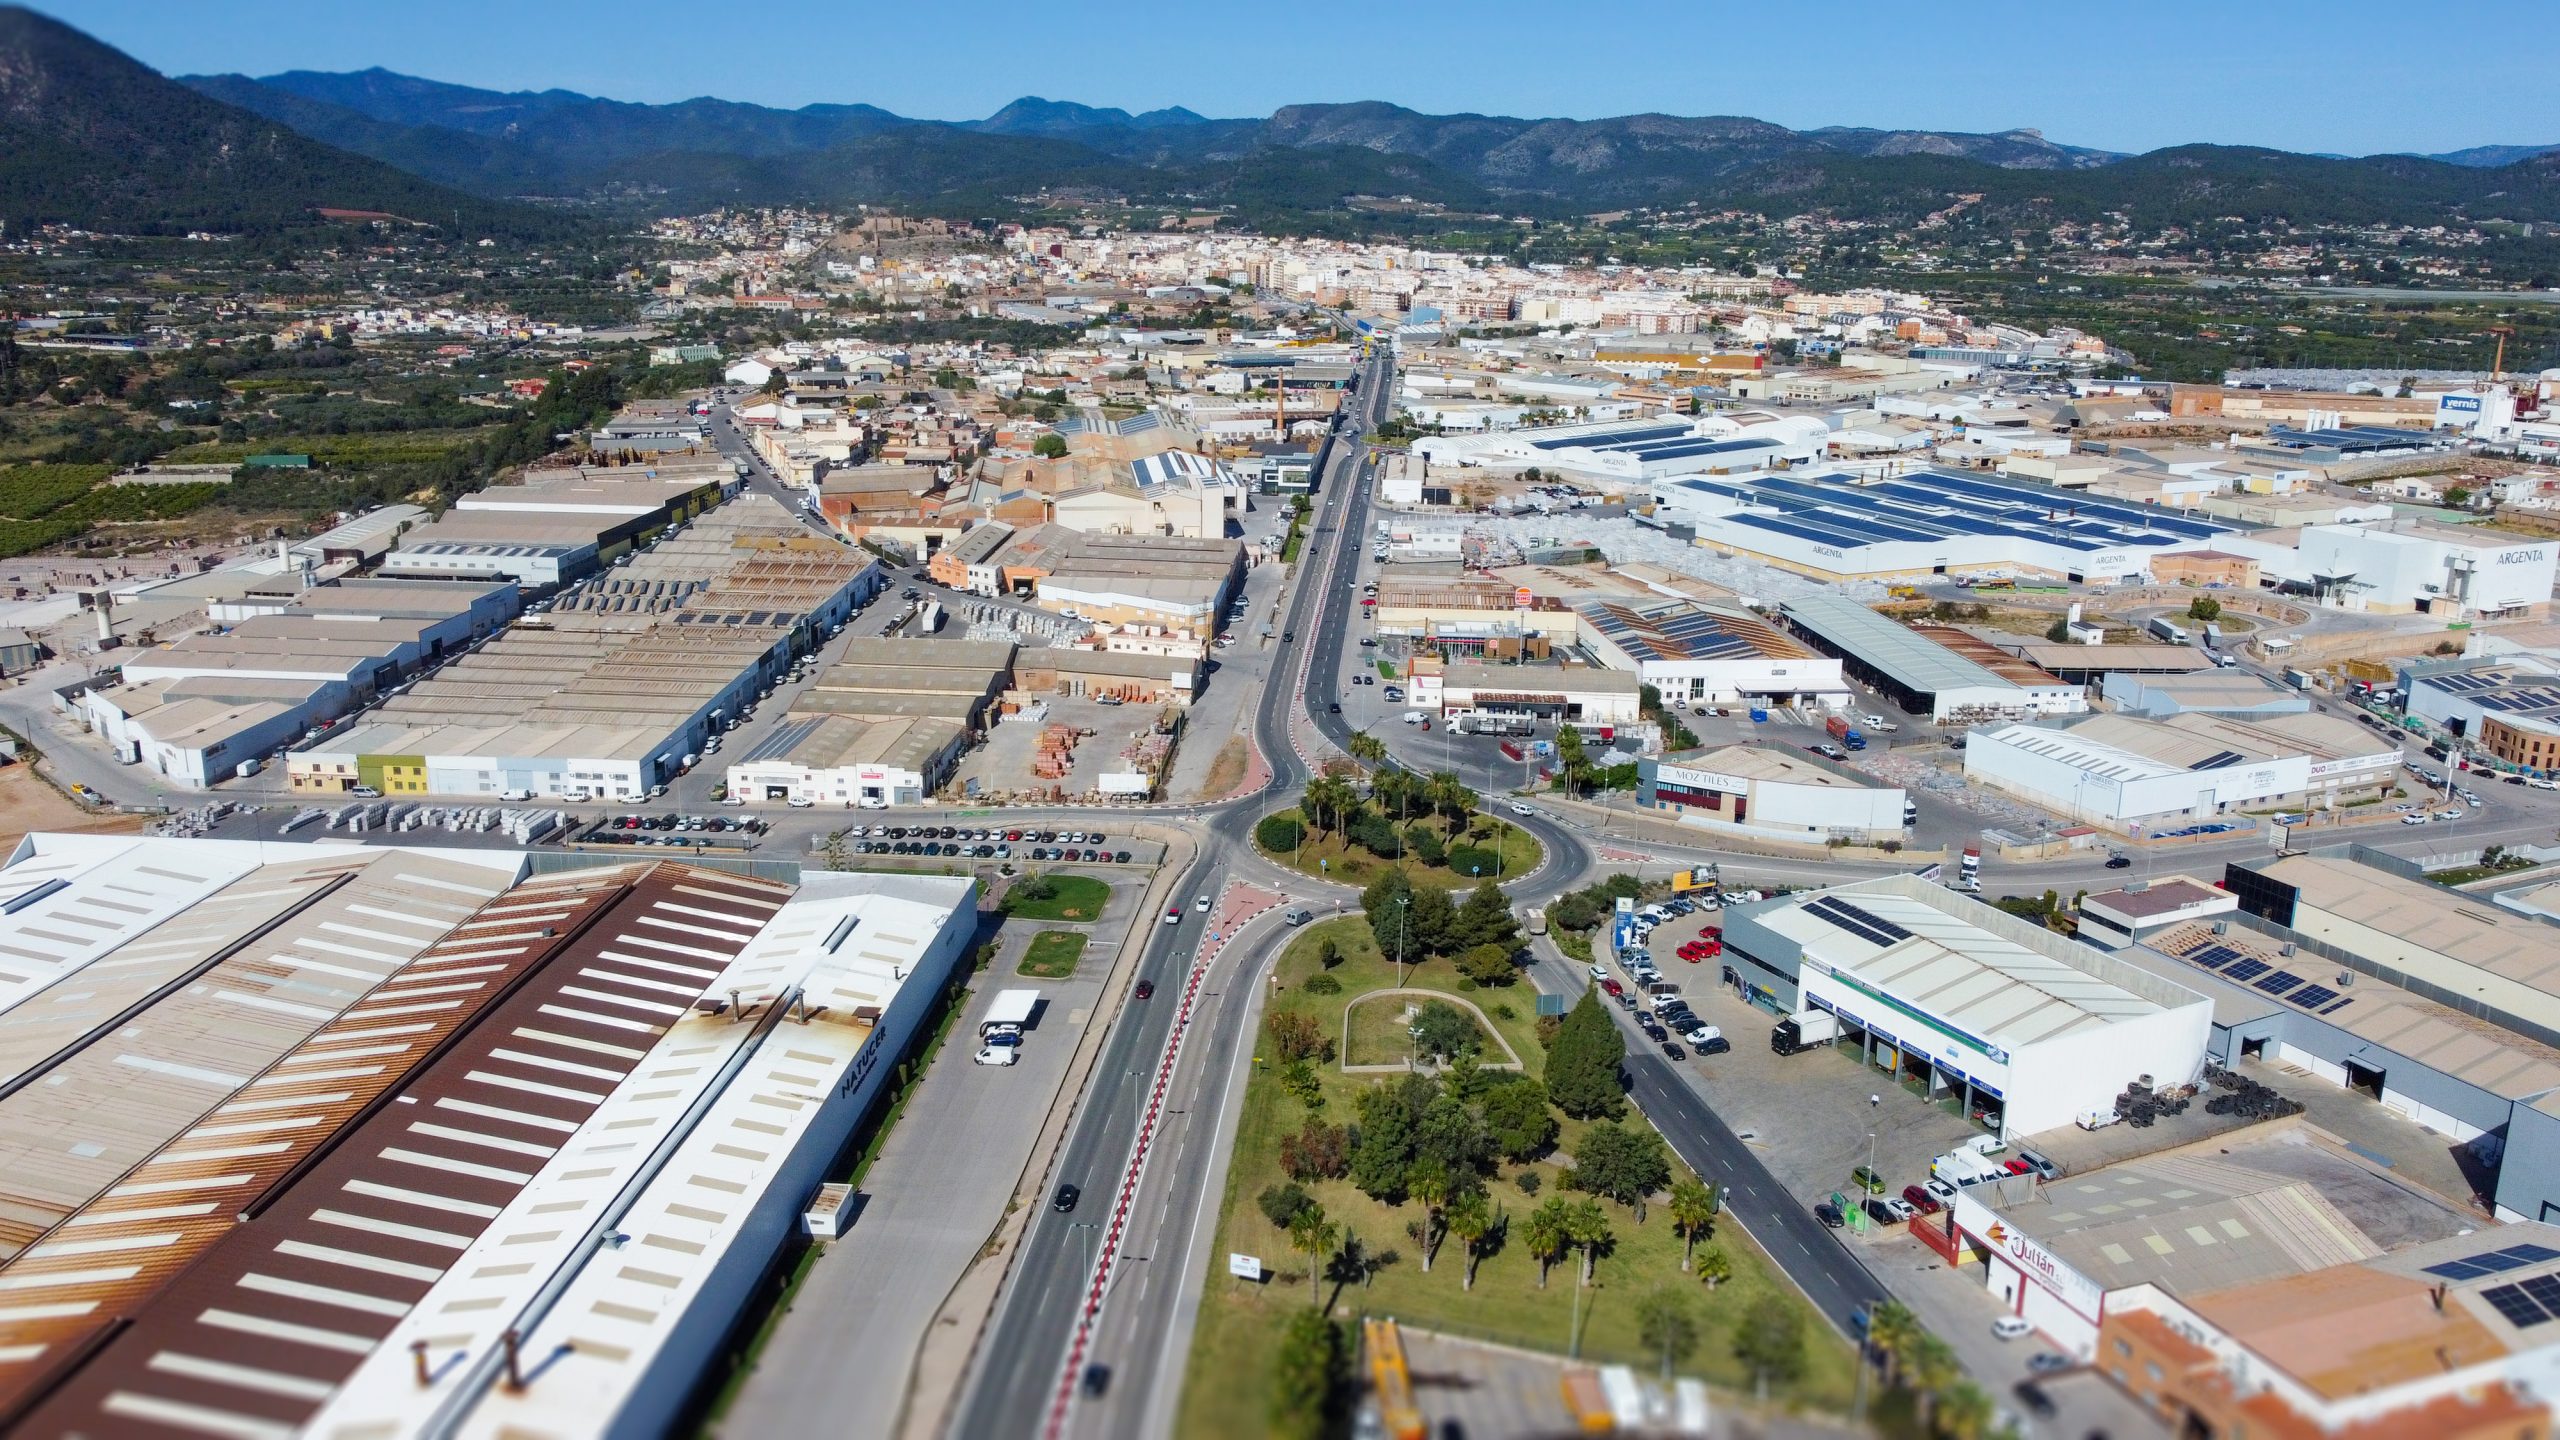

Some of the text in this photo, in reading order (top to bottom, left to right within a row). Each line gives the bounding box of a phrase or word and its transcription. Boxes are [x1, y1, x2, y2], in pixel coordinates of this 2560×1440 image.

[1812, 545, 1843, 559] ARGENTA
[2095, 555, 2127, 564] ARGENTA
[2496, 549, 2543, 565] ARGENTA
[2311, 765, 2326, 774] DUO
[1675, 770, 1729, 787] MOZ TILES
[842, 1026, 886, 1099] NATUCER
[2011, 1236, 2055, 1277] Julián
